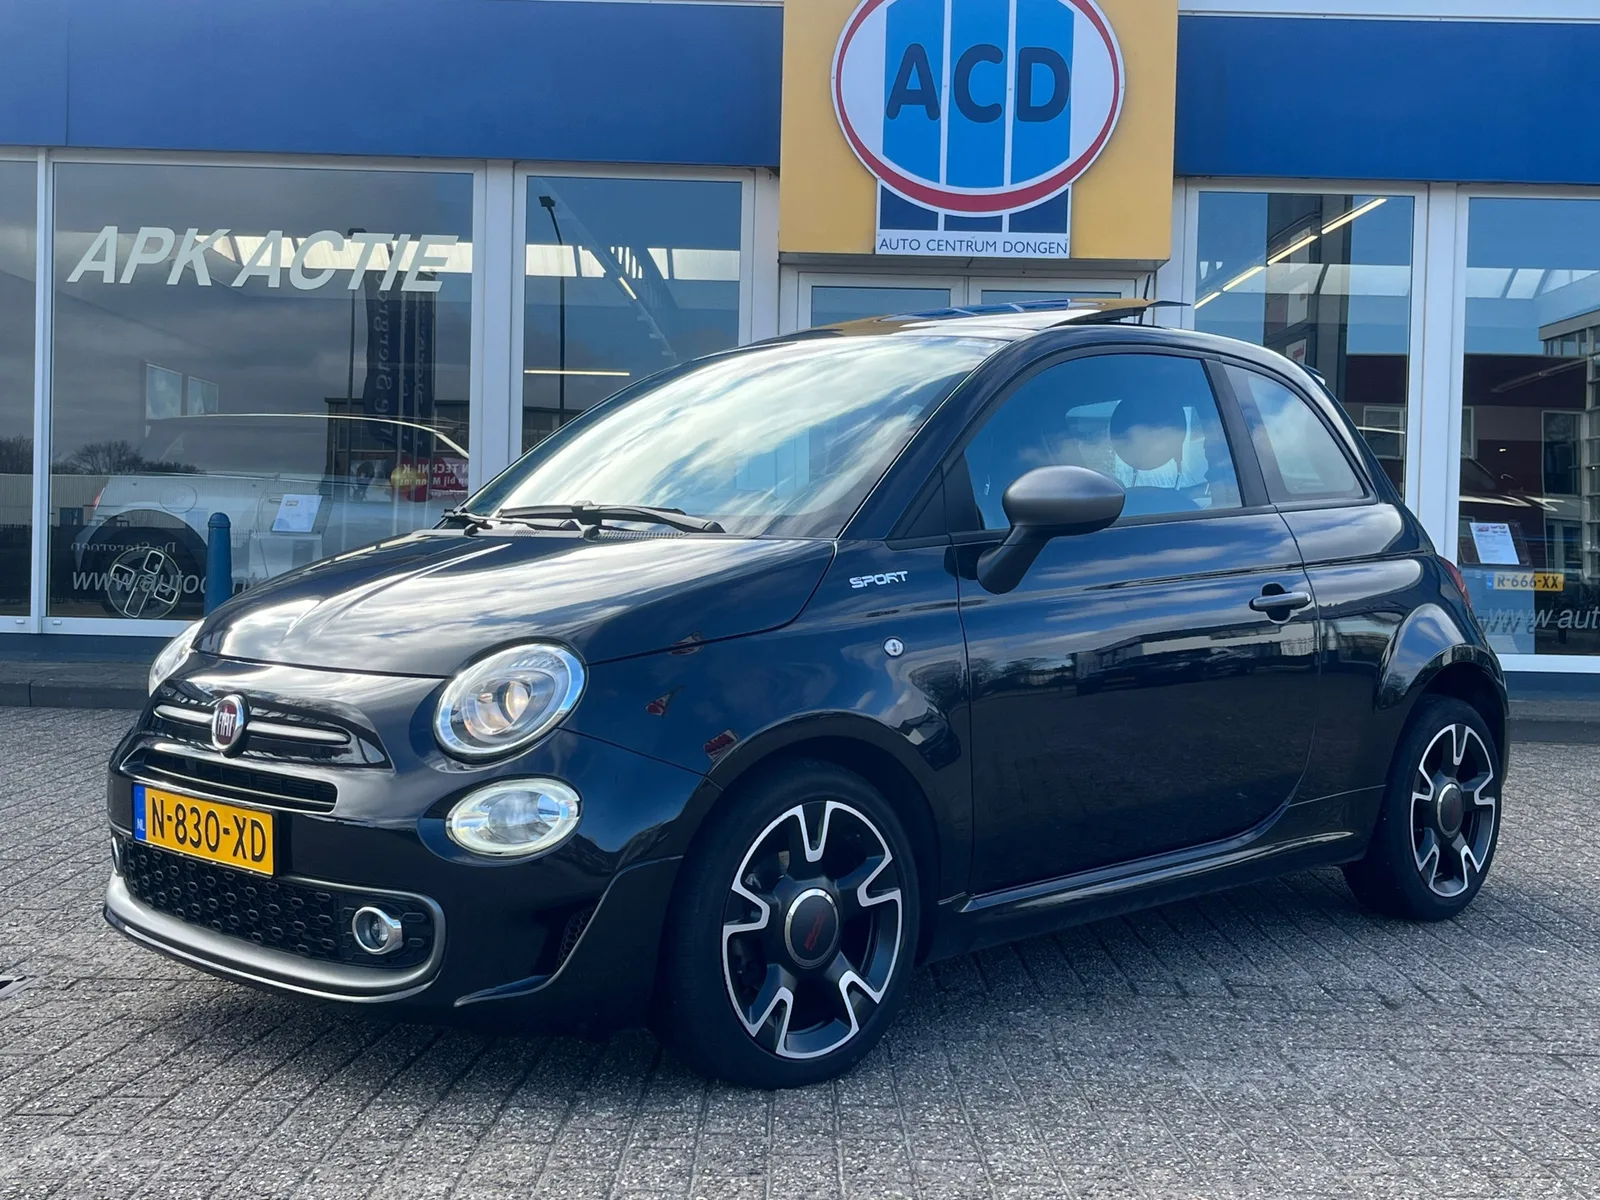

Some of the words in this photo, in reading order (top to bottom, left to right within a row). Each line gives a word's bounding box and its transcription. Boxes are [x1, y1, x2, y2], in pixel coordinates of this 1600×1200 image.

[886, 43, 1070, 123] ACD
[879, 238, 921, 251] AUTO
[926, 239, 997, 253] CENTRUM
[1003, 240, 1068, 254] DONGEN
[67, 226, 231, 287] APK
[232, 229, 459, 292] ACTIE
[849, 570, 908, 589] SPORT
[1497, 574, 1560, 589] R-666-XX
[217, 708, 236, 737] FIAT
[136, 817, 145, 831] NL
[151, 796, 267, 863] N-830-XD
